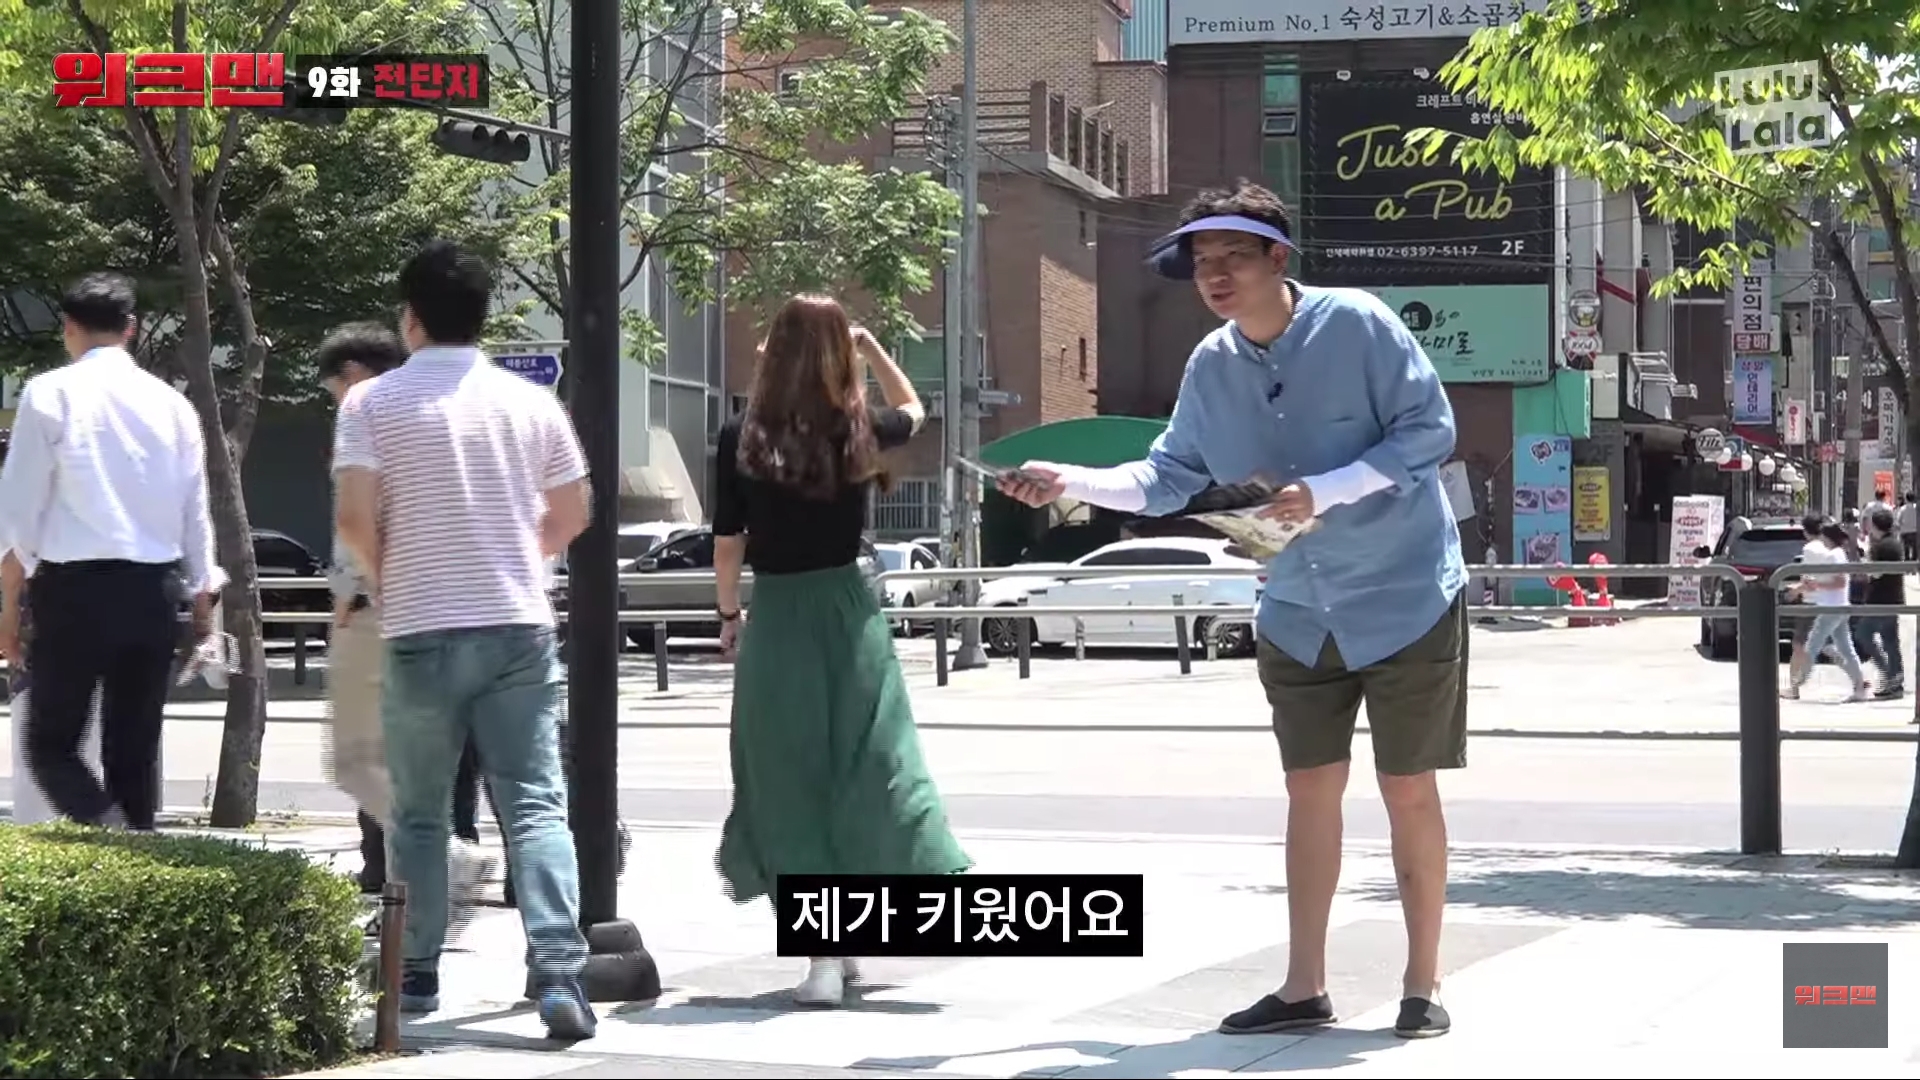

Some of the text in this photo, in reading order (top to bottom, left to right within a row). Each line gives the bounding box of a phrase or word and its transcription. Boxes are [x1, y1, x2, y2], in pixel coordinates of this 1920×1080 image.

[1185, 16, 1275, 33] Premium
[1286, 15, 1330, 33] No.1
[1374, 179, 1513, 221] a Pub
[1377, 246, 1478, 258] 02-6397-5117
[1501, 240, 1525, 255] 2F
[1743, 275, 1762, 332] 편의점
[1736, 334, 1768, 350] 담배
